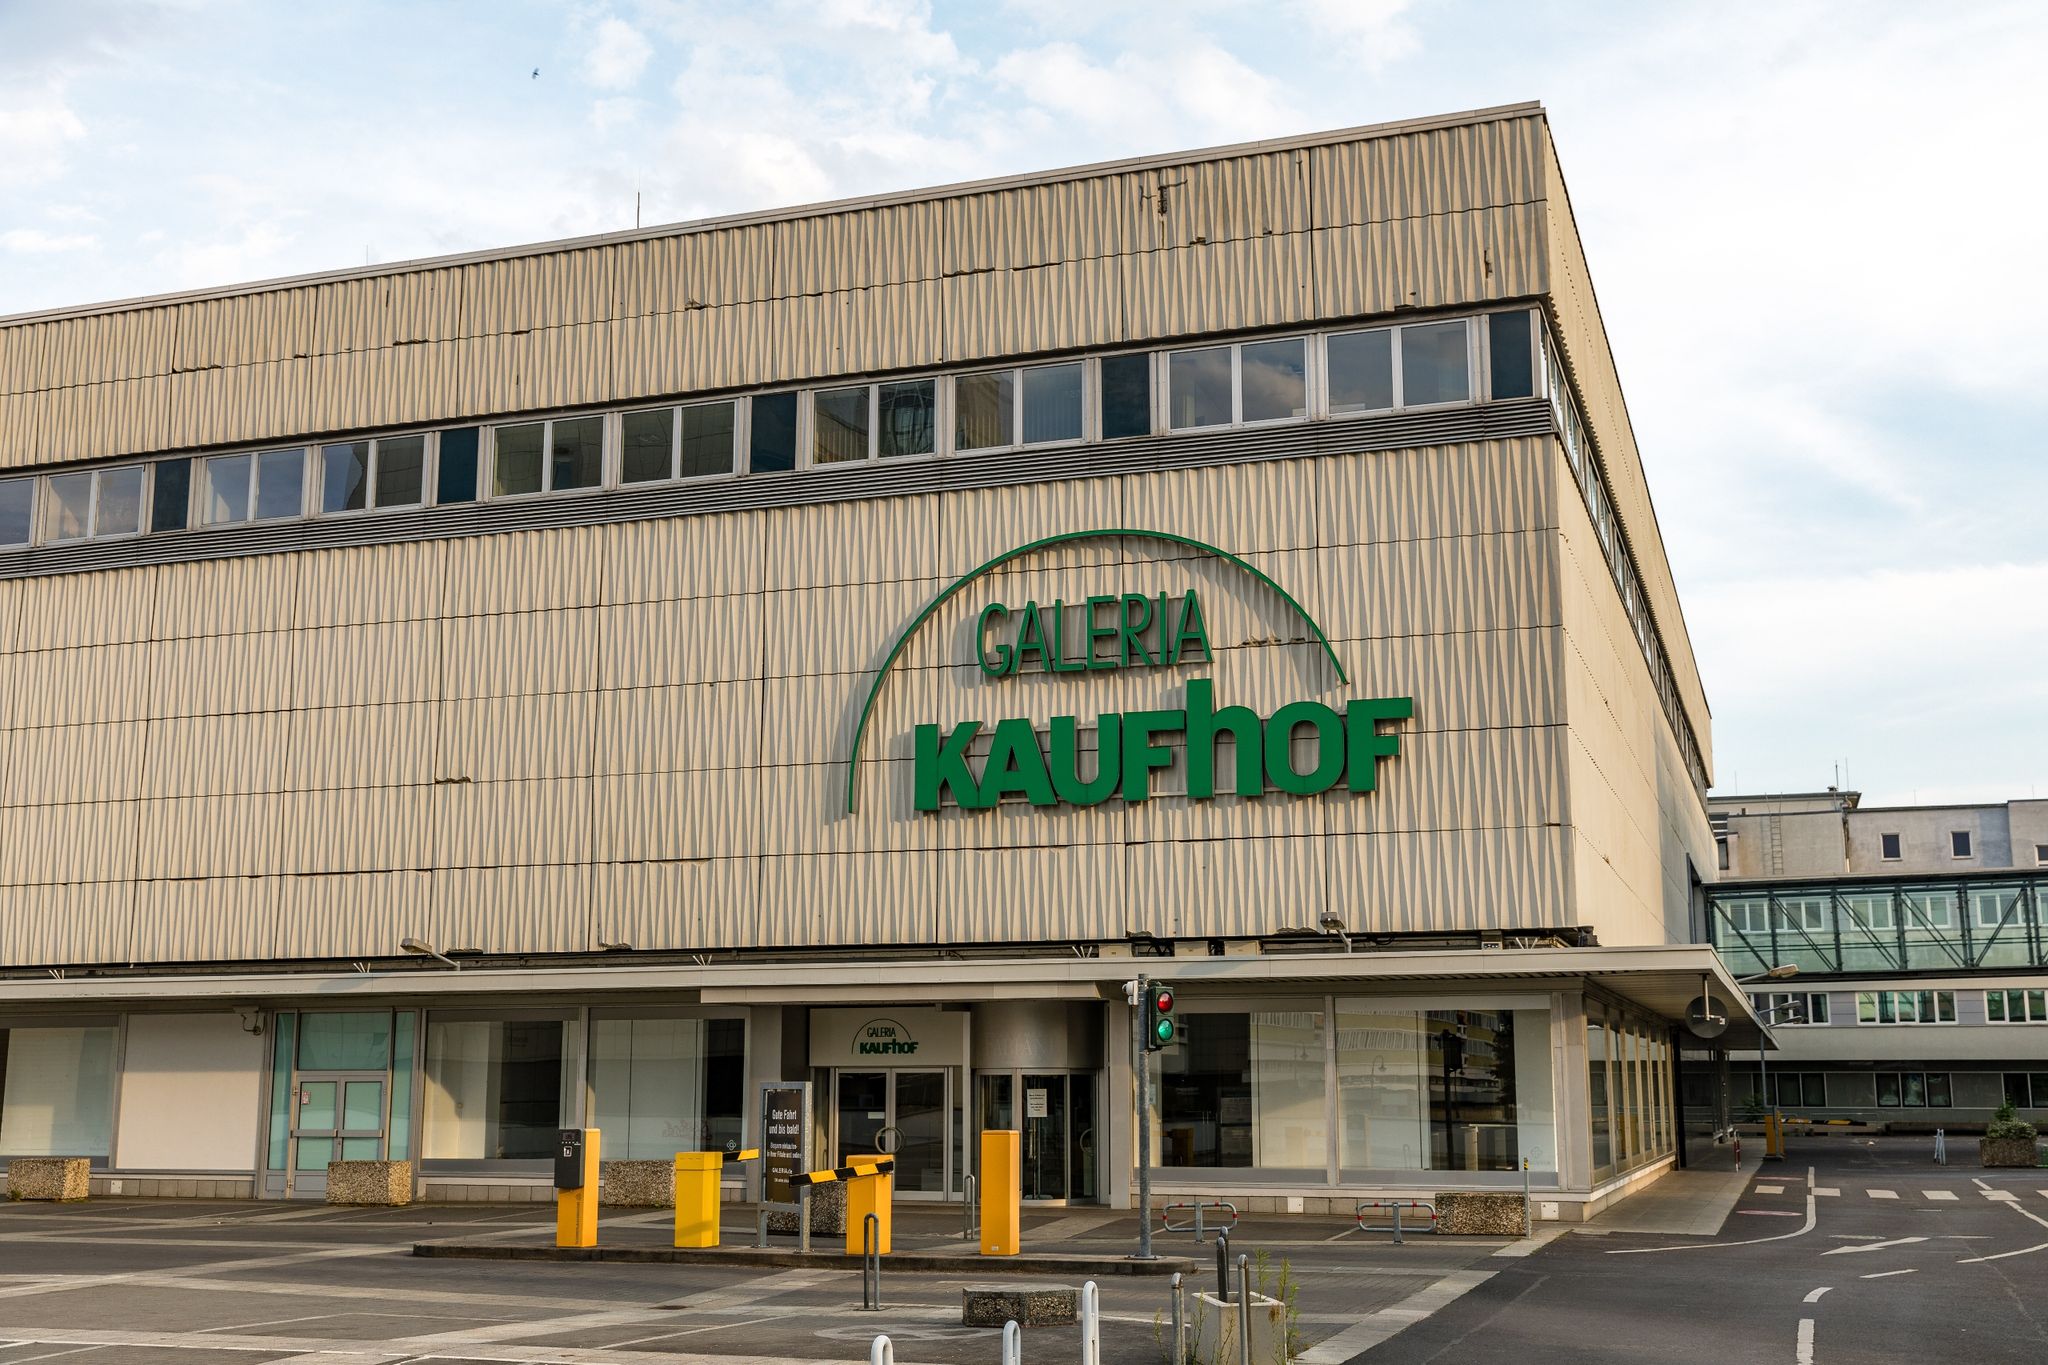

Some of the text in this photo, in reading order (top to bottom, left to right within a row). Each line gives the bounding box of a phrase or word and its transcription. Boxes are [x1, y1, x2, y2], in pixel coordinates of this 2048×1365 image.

[976, 588, 1214, 678] GALERIA
[867, 1027, 896, 1038] GALERIA
[772, 1109, 797, 1120] Gute Fahrt
[769, 1124, 800, 1135] und bis bald!
